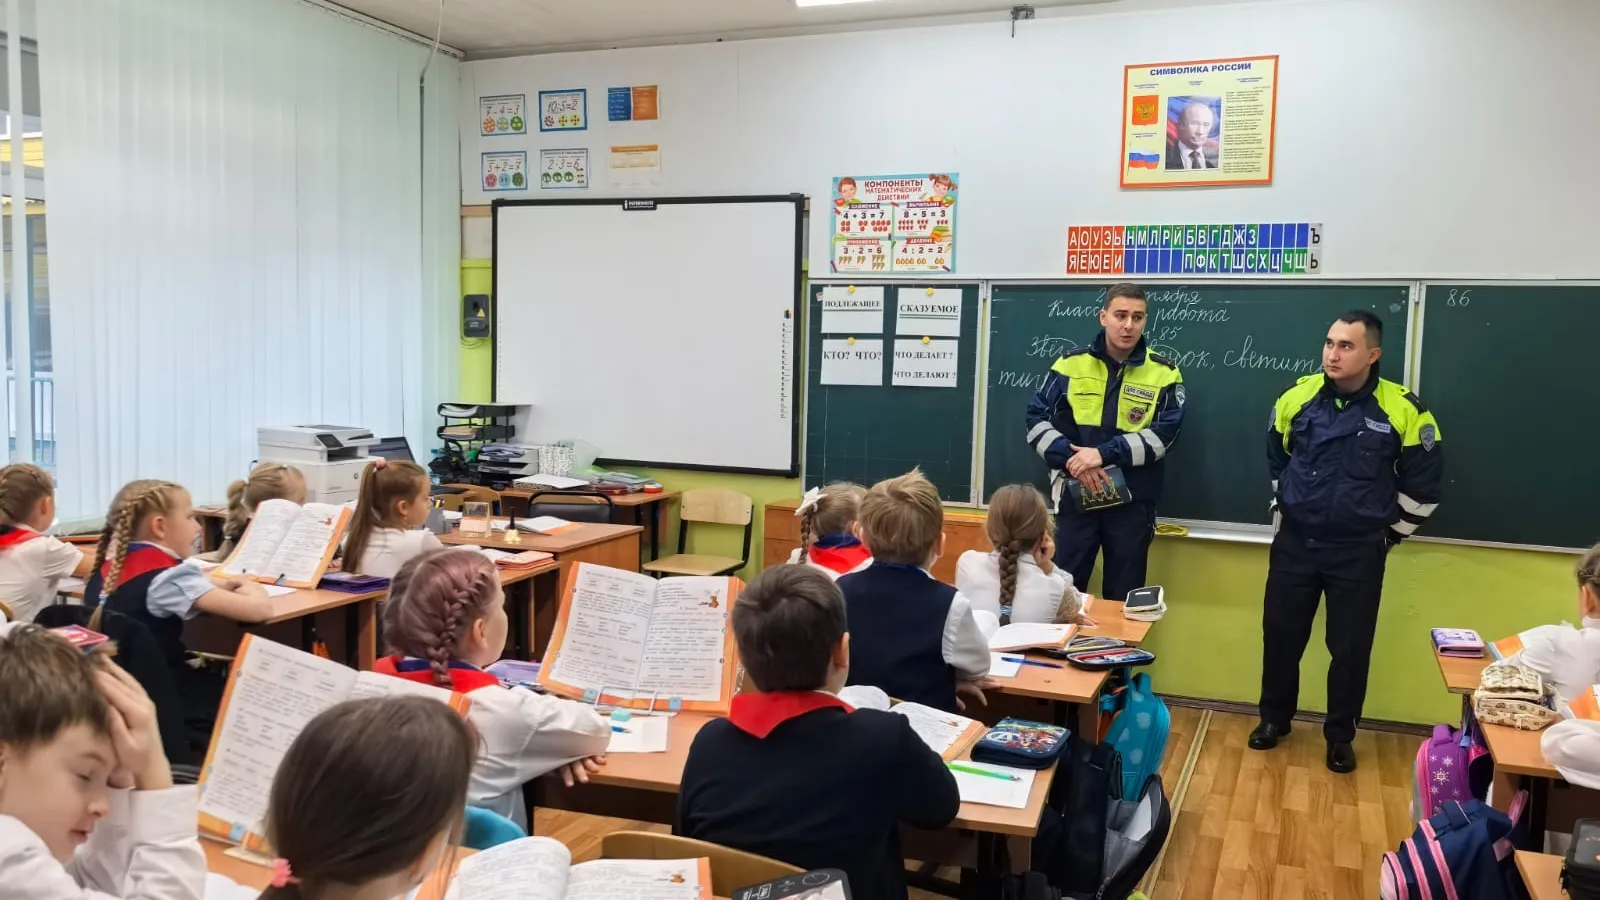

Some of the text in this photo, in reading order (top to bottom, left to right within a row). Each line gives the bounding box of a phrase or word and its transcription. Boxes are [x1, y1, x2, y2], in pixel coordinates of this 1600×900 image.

[1150, 62, 1252, 76] СИМВОЛИКА РОССИИ
[864, 179, 923, 188] КОМПОНЕНТЫ
[1446, 288, 1473, 307] 86
[824, 300, 881, 308] ПОДЛЕЖАЩЕЕ
[899, 304, 959, 314] СКАЗУЕМОЕ
[1152, 302, 1231, 332] работа
[1159, 325, 1184, 341] 85
[823, 350, 882, 360] КТО? ЧТО?
[895, 351, 913, 359] ЧТО
[913, 352, 947, 360] ДЕЛАЕТ
[894, 370, 912, 378] ЧТО
[912, 371, 951, 379] ДЕЛАЮТ
